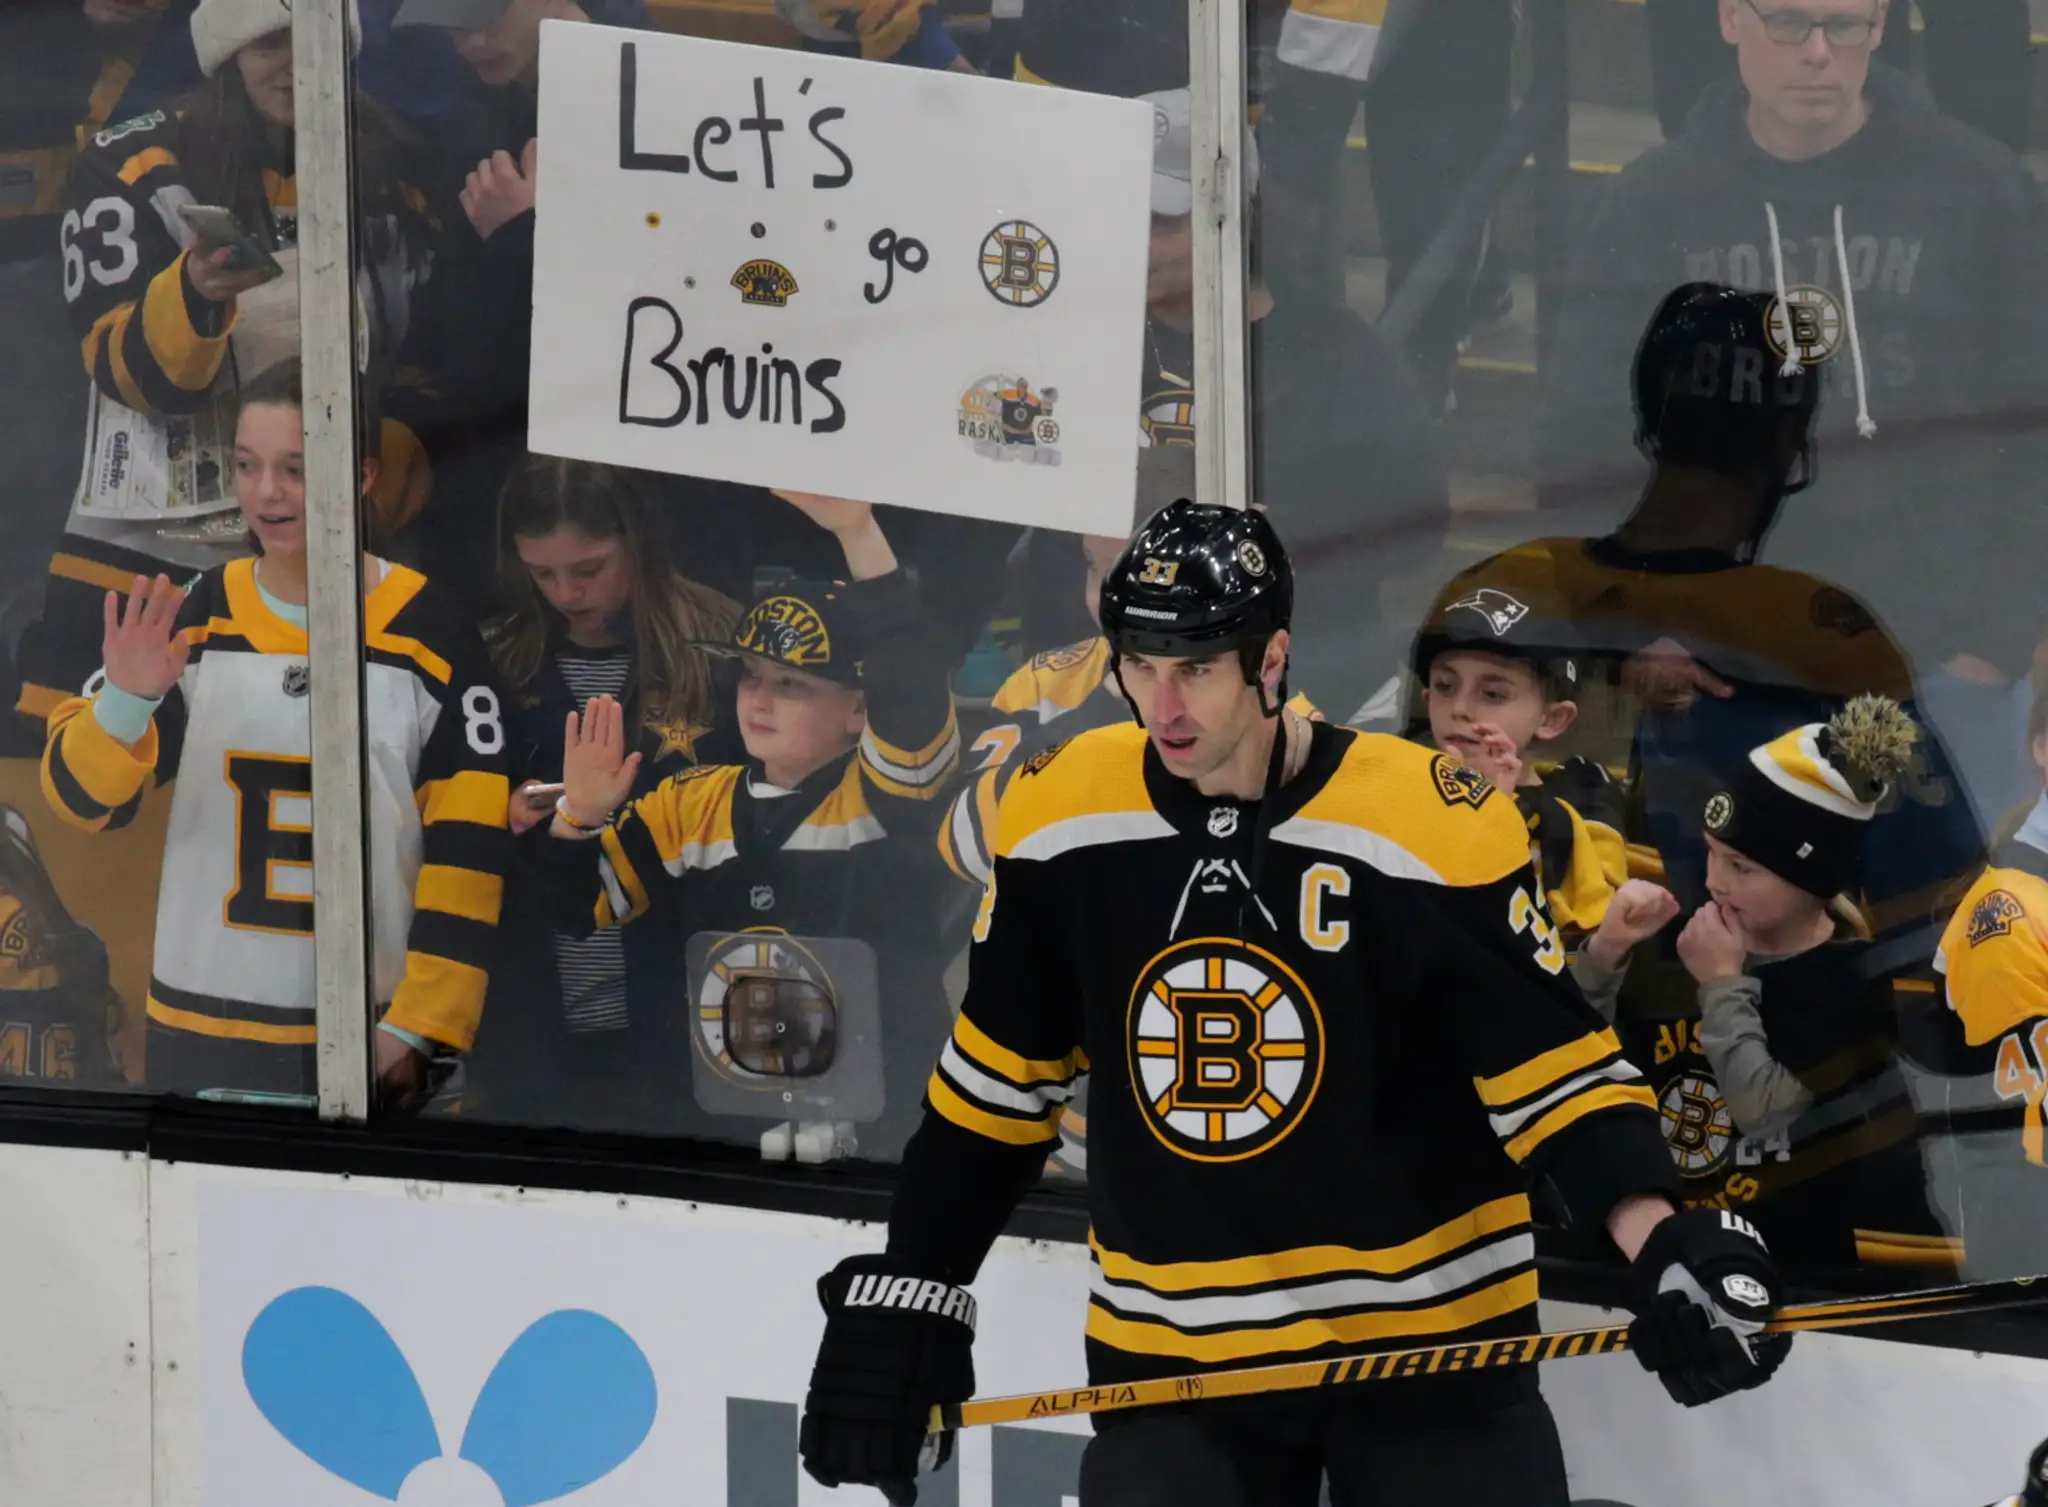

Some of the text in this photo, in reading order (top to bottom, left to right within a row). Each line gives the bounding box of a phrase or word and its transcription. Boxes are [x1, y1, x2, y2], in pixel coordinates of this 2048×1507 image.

[619, 42, 853, 190] Let's
[60, 196, 139, 304] 63
[734, 262, 795, 293] BRUINS
[863, 227, 929, 304] go
[619, 296, 846, 433] Bruins
[1138, 556, 1181, 587] 33
[1124, 605, 1178, 621] WARRIOR
[460, 685, 506, 755] 8
[1300, 862, 1350, 952] C
[1168, 987, 1264, 1112] B
[1027, 1385, 1138, 1417] ALPHA
